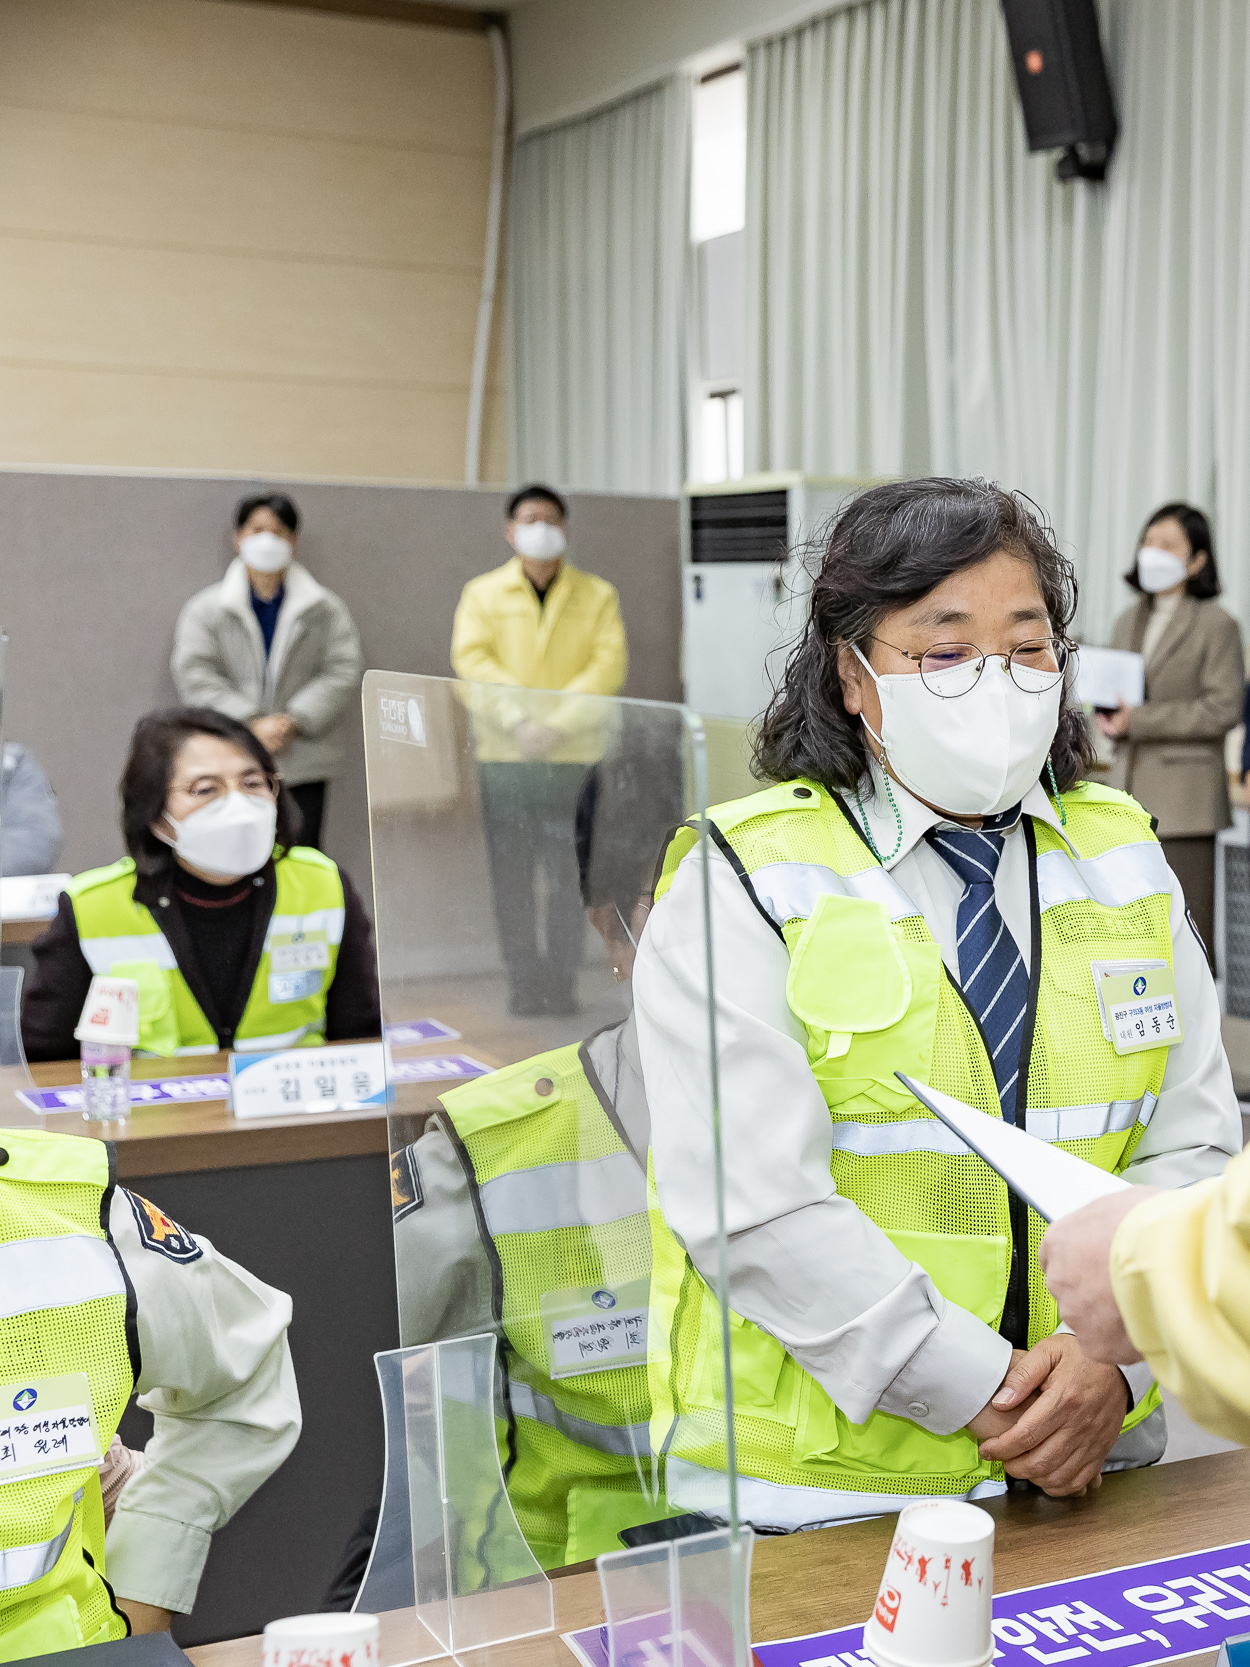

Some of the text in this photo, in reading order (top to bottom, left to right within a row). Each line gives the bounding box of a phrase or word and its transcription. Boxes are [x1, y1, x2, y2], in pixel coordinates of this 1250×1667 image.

[1114, 1010, 1128, 1020] 광진구
[1128, 1007, 1144, 1017] 구의3동
[1144, 1005, 1154, 1014] 여성
